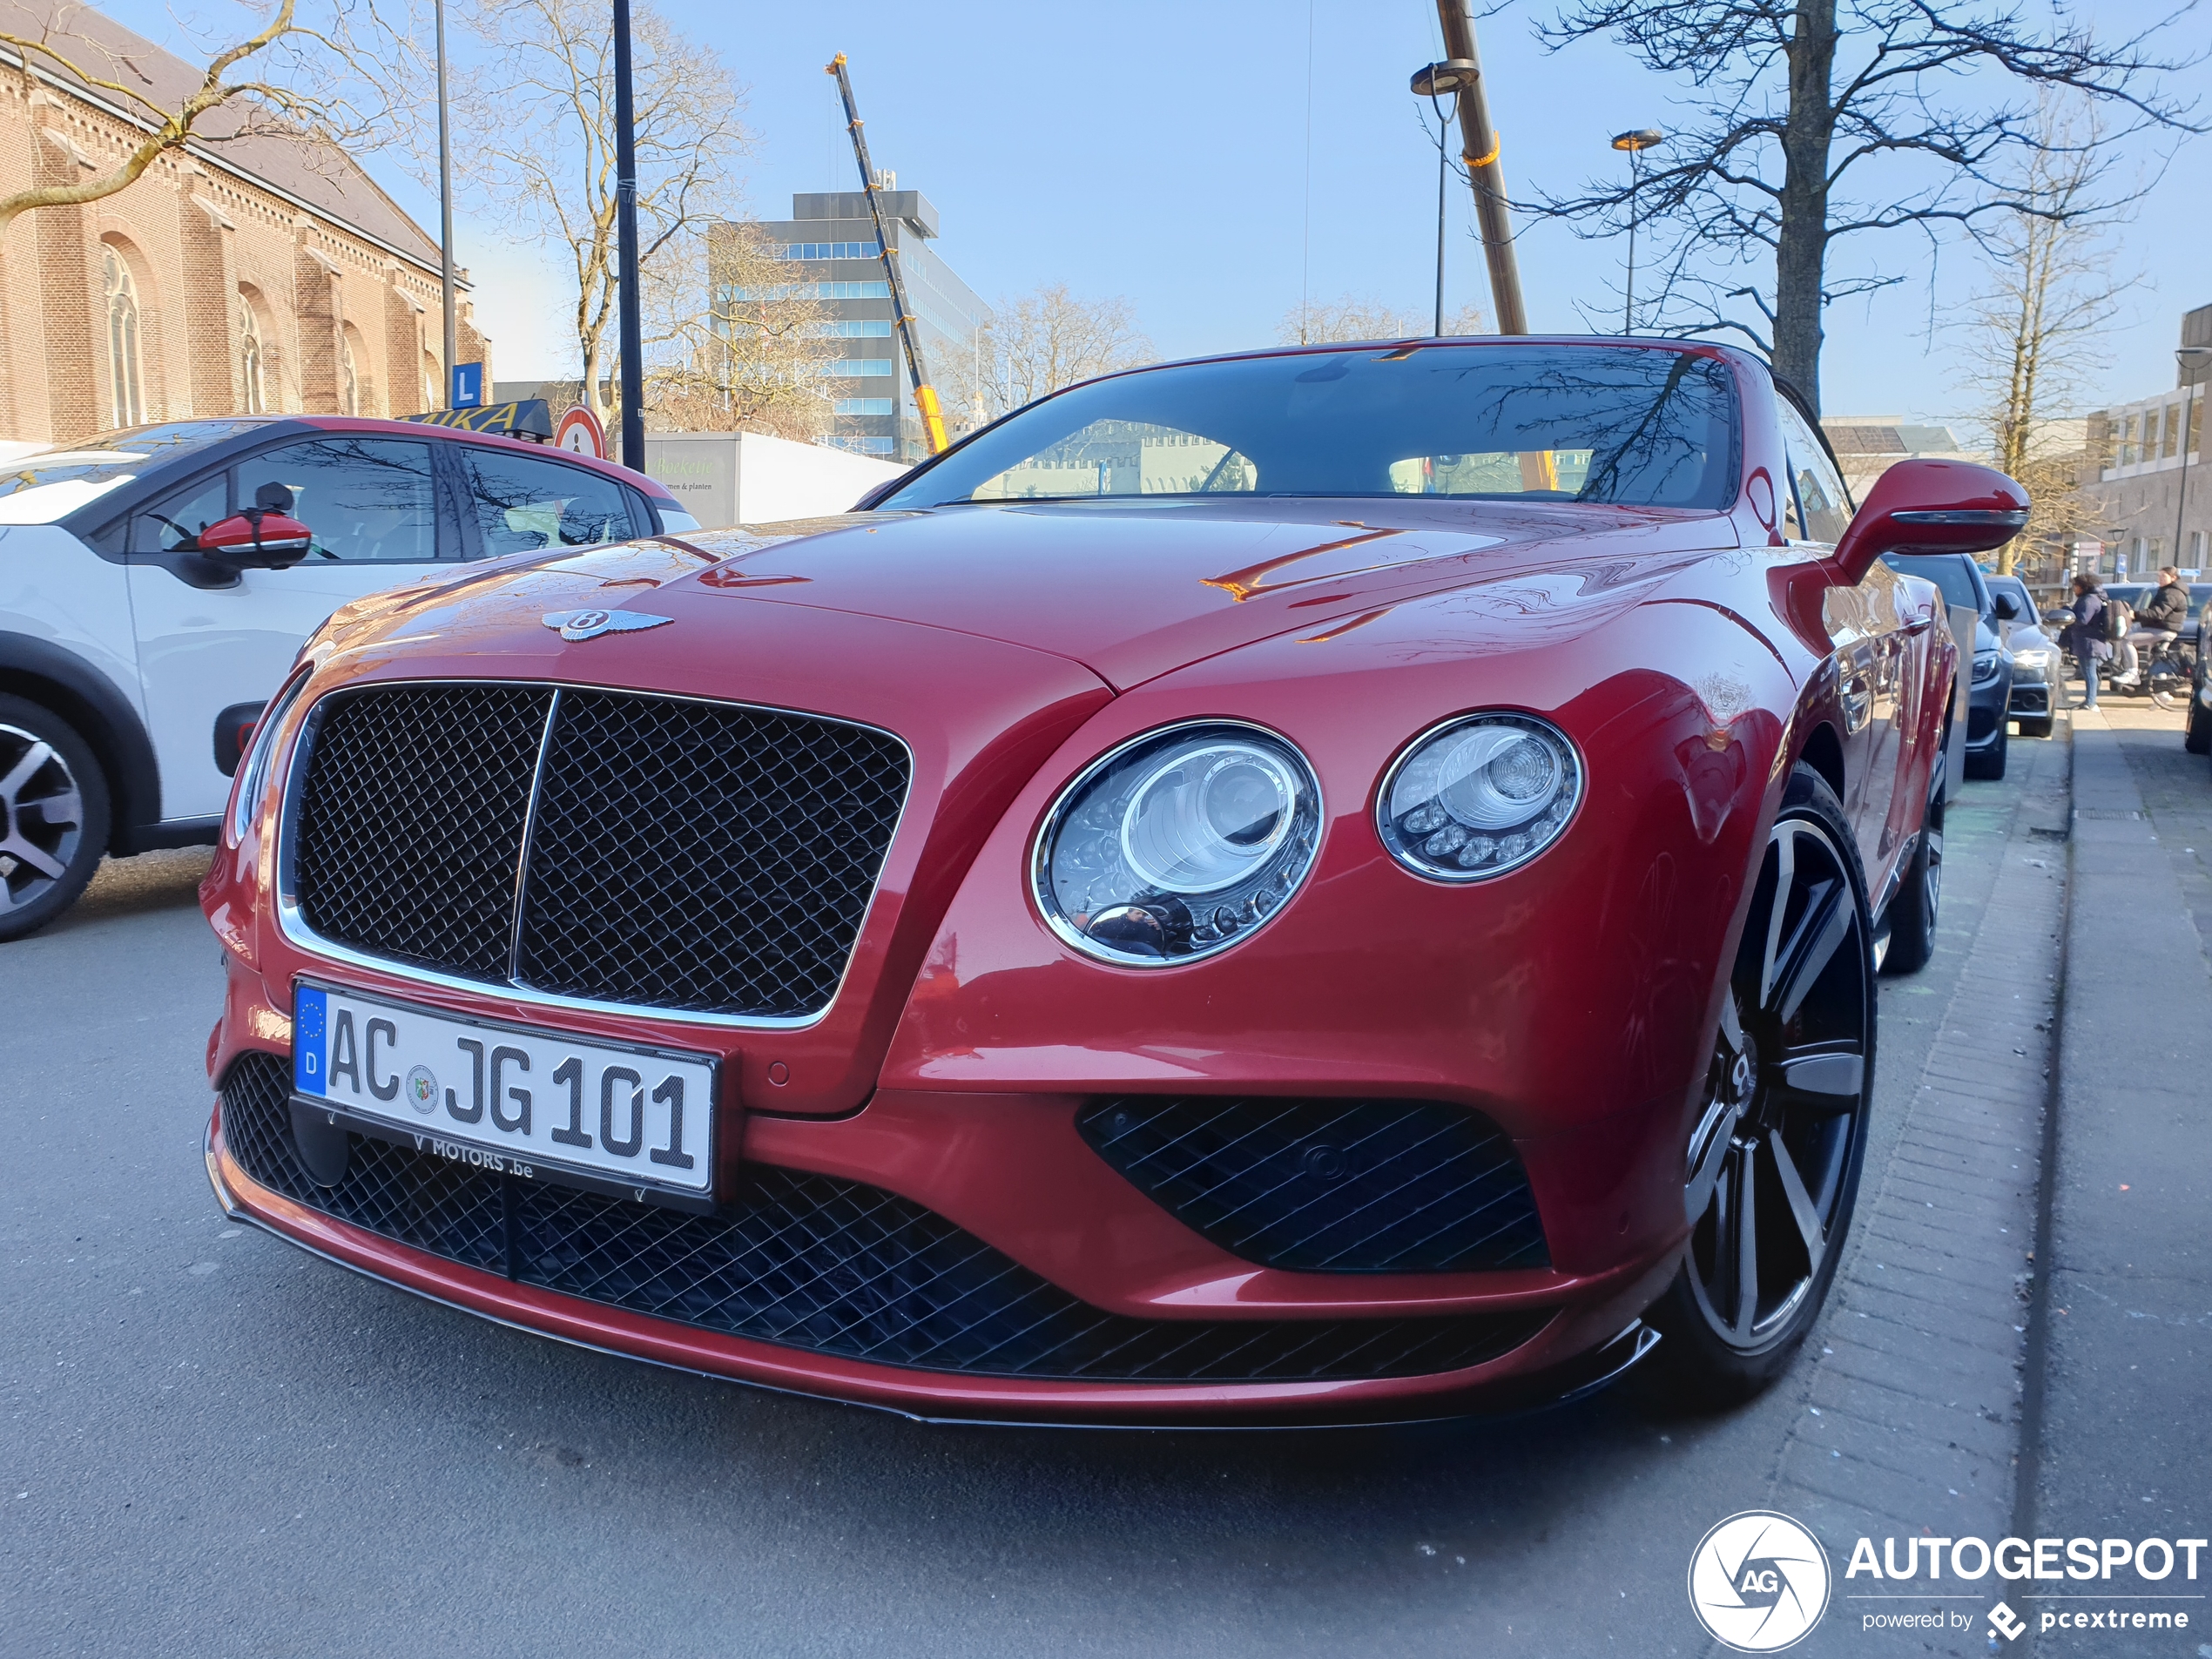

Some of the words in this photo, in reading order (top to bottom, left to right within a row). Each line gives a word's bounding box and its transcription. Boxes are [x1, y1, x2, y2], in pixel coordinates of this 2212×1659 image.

[459, 372, 474, 401] L
[654, 455, 713, 480] Boeketje
[689, 482, 712, 492] planten
[570, 611, 604, 628] B
[305, 1051, 317, 1076] D
[327, 1008, 400, 1103] AC
[445, 1036, 533, 1136] JG
[550, 1056, 695, 1170] 101
[432, 1138, 505, 1172] MOTORS
[509, 1159, 534, 1178] .be
